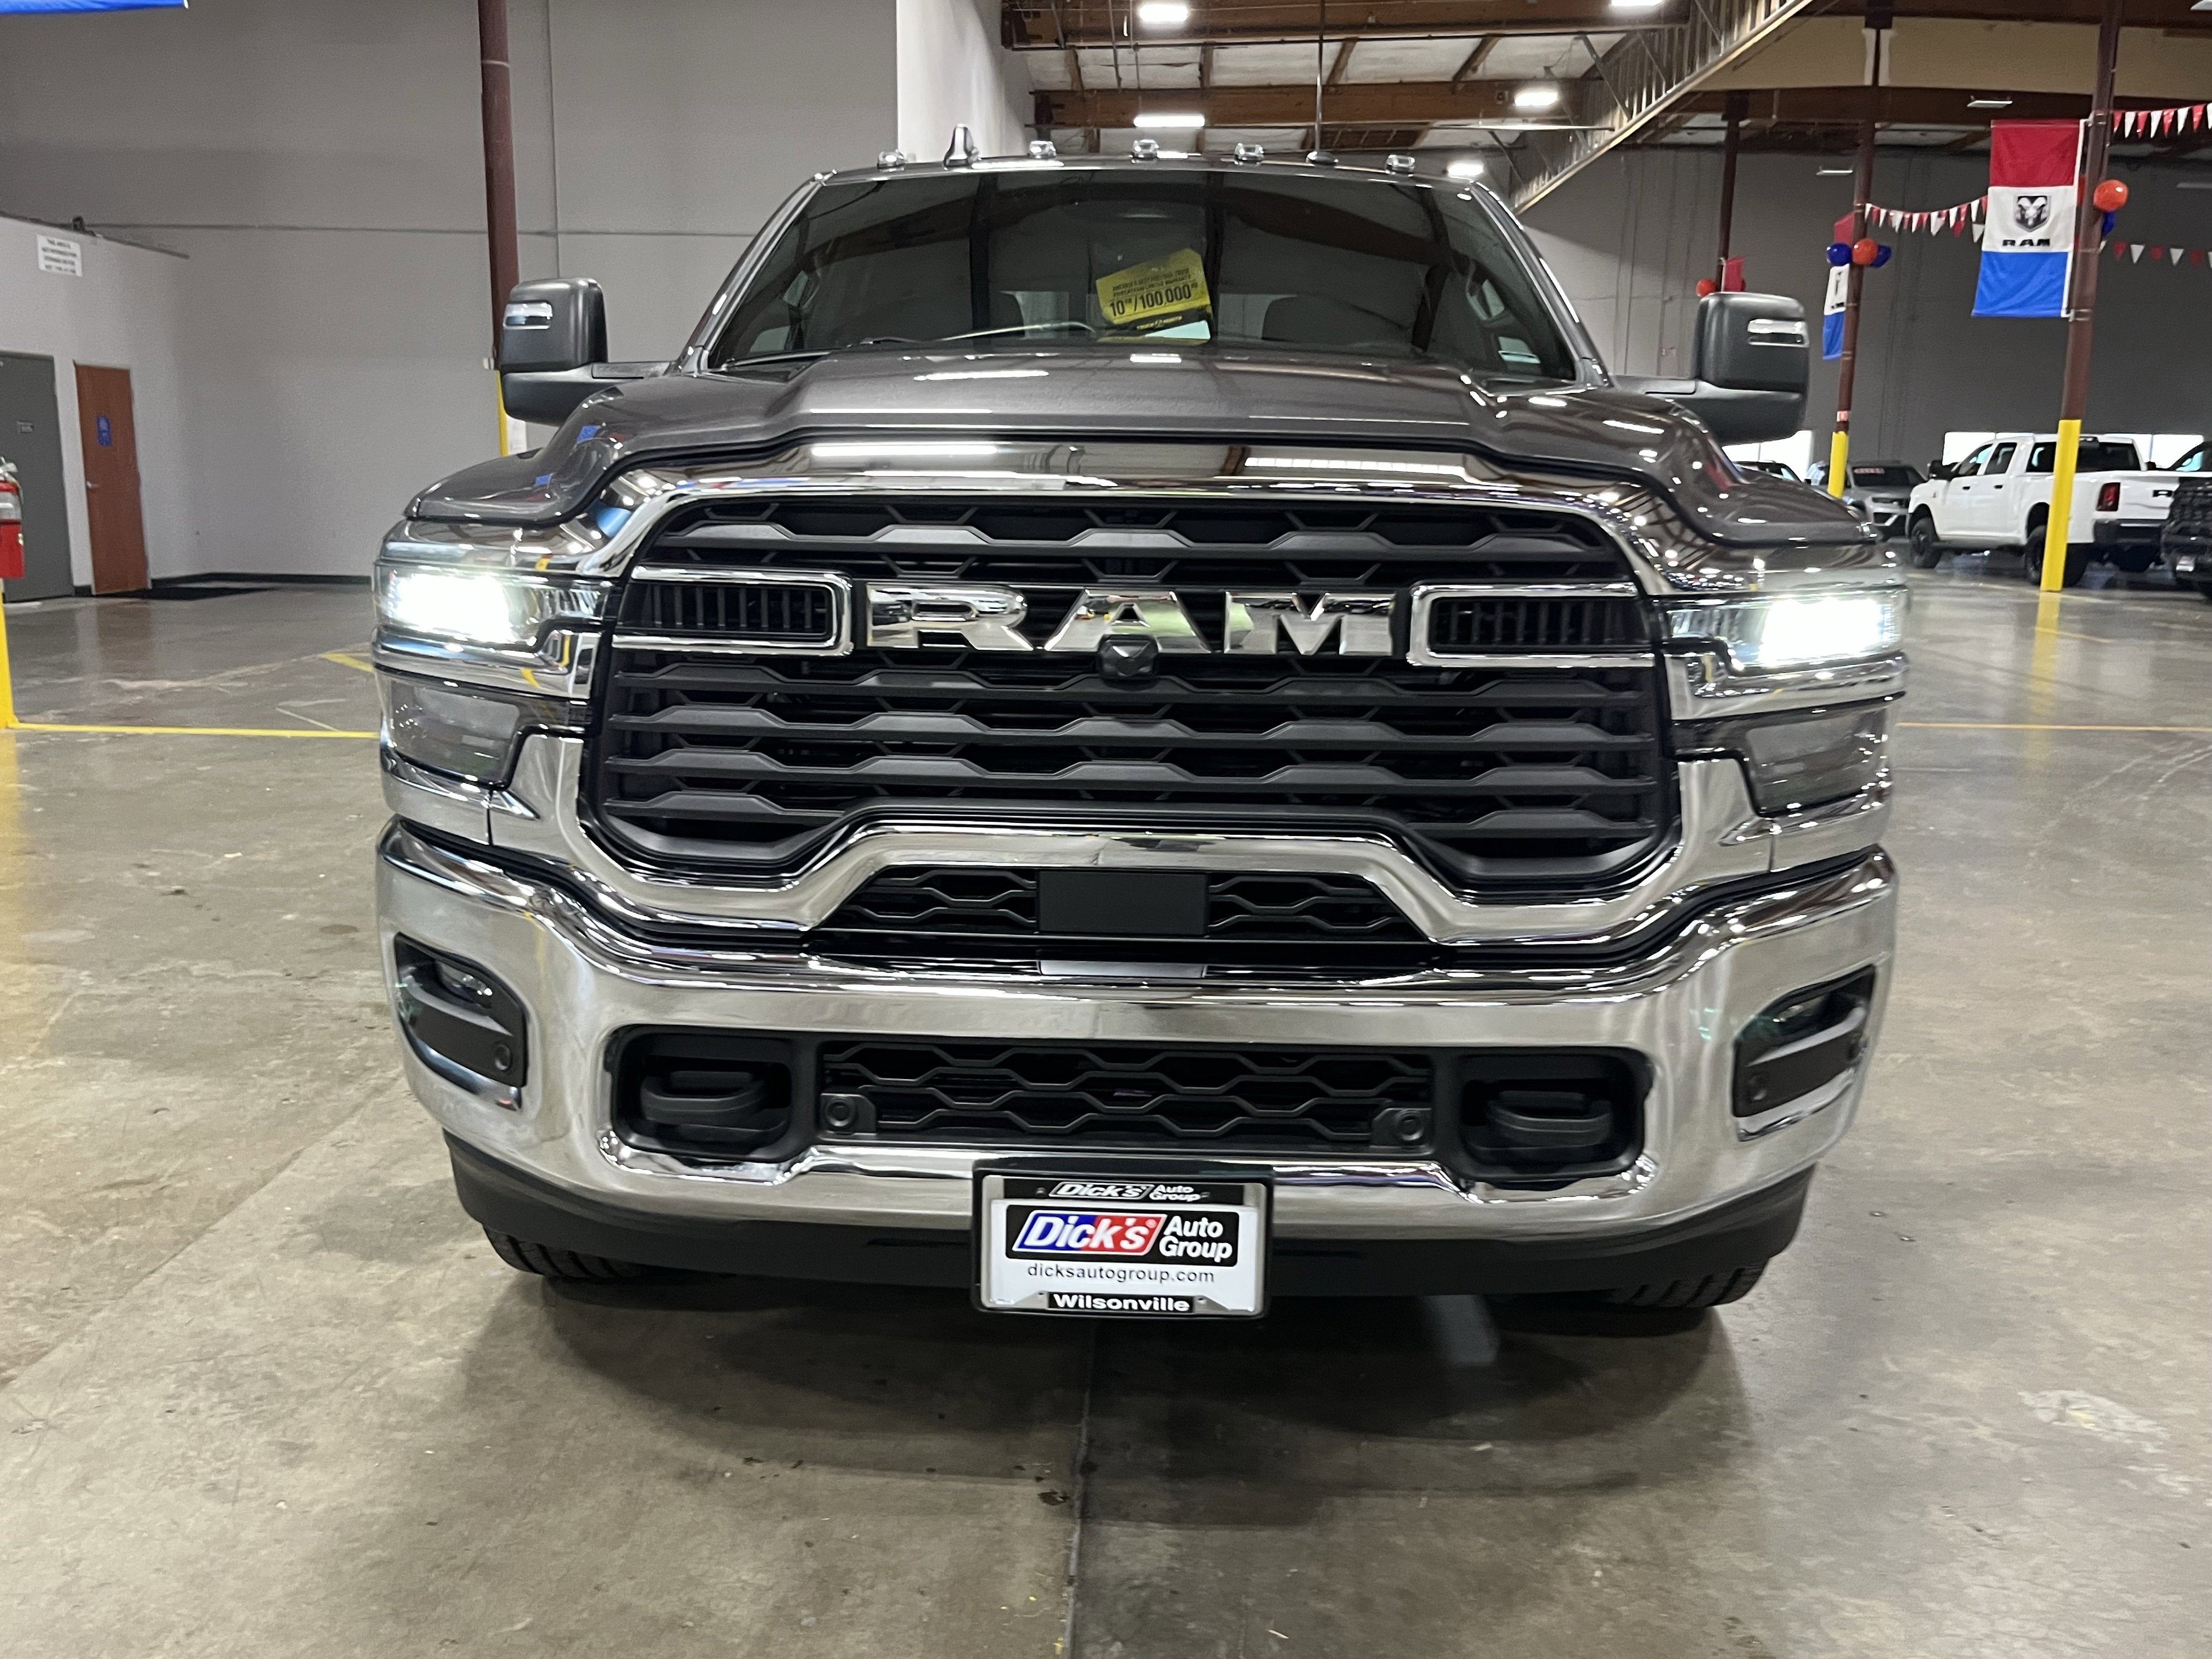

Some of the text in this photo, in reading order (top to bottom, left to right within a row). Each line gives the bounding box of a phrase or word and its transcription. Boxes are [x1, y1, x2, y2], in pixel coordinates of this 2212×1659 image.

[2002, 238, 2050, 246] RAM
[866, 582, 1396, 656] RAM
[1057, 1183, 1143, 1198] Dick's
[1149, 1191, 1201, 1202] Group
[1154, 1184, 1194, 1193] Auto
[1024, 1215, 1150, 1251] Dick's
[1164, 1216, 1223, 1238] Auto
[1159, 1235, 1233, 1262] Group
[1028, 1263, 1215, 1283] dicksautogroup.com
[1053, 1293, 1190, 1312] Wilsonville
